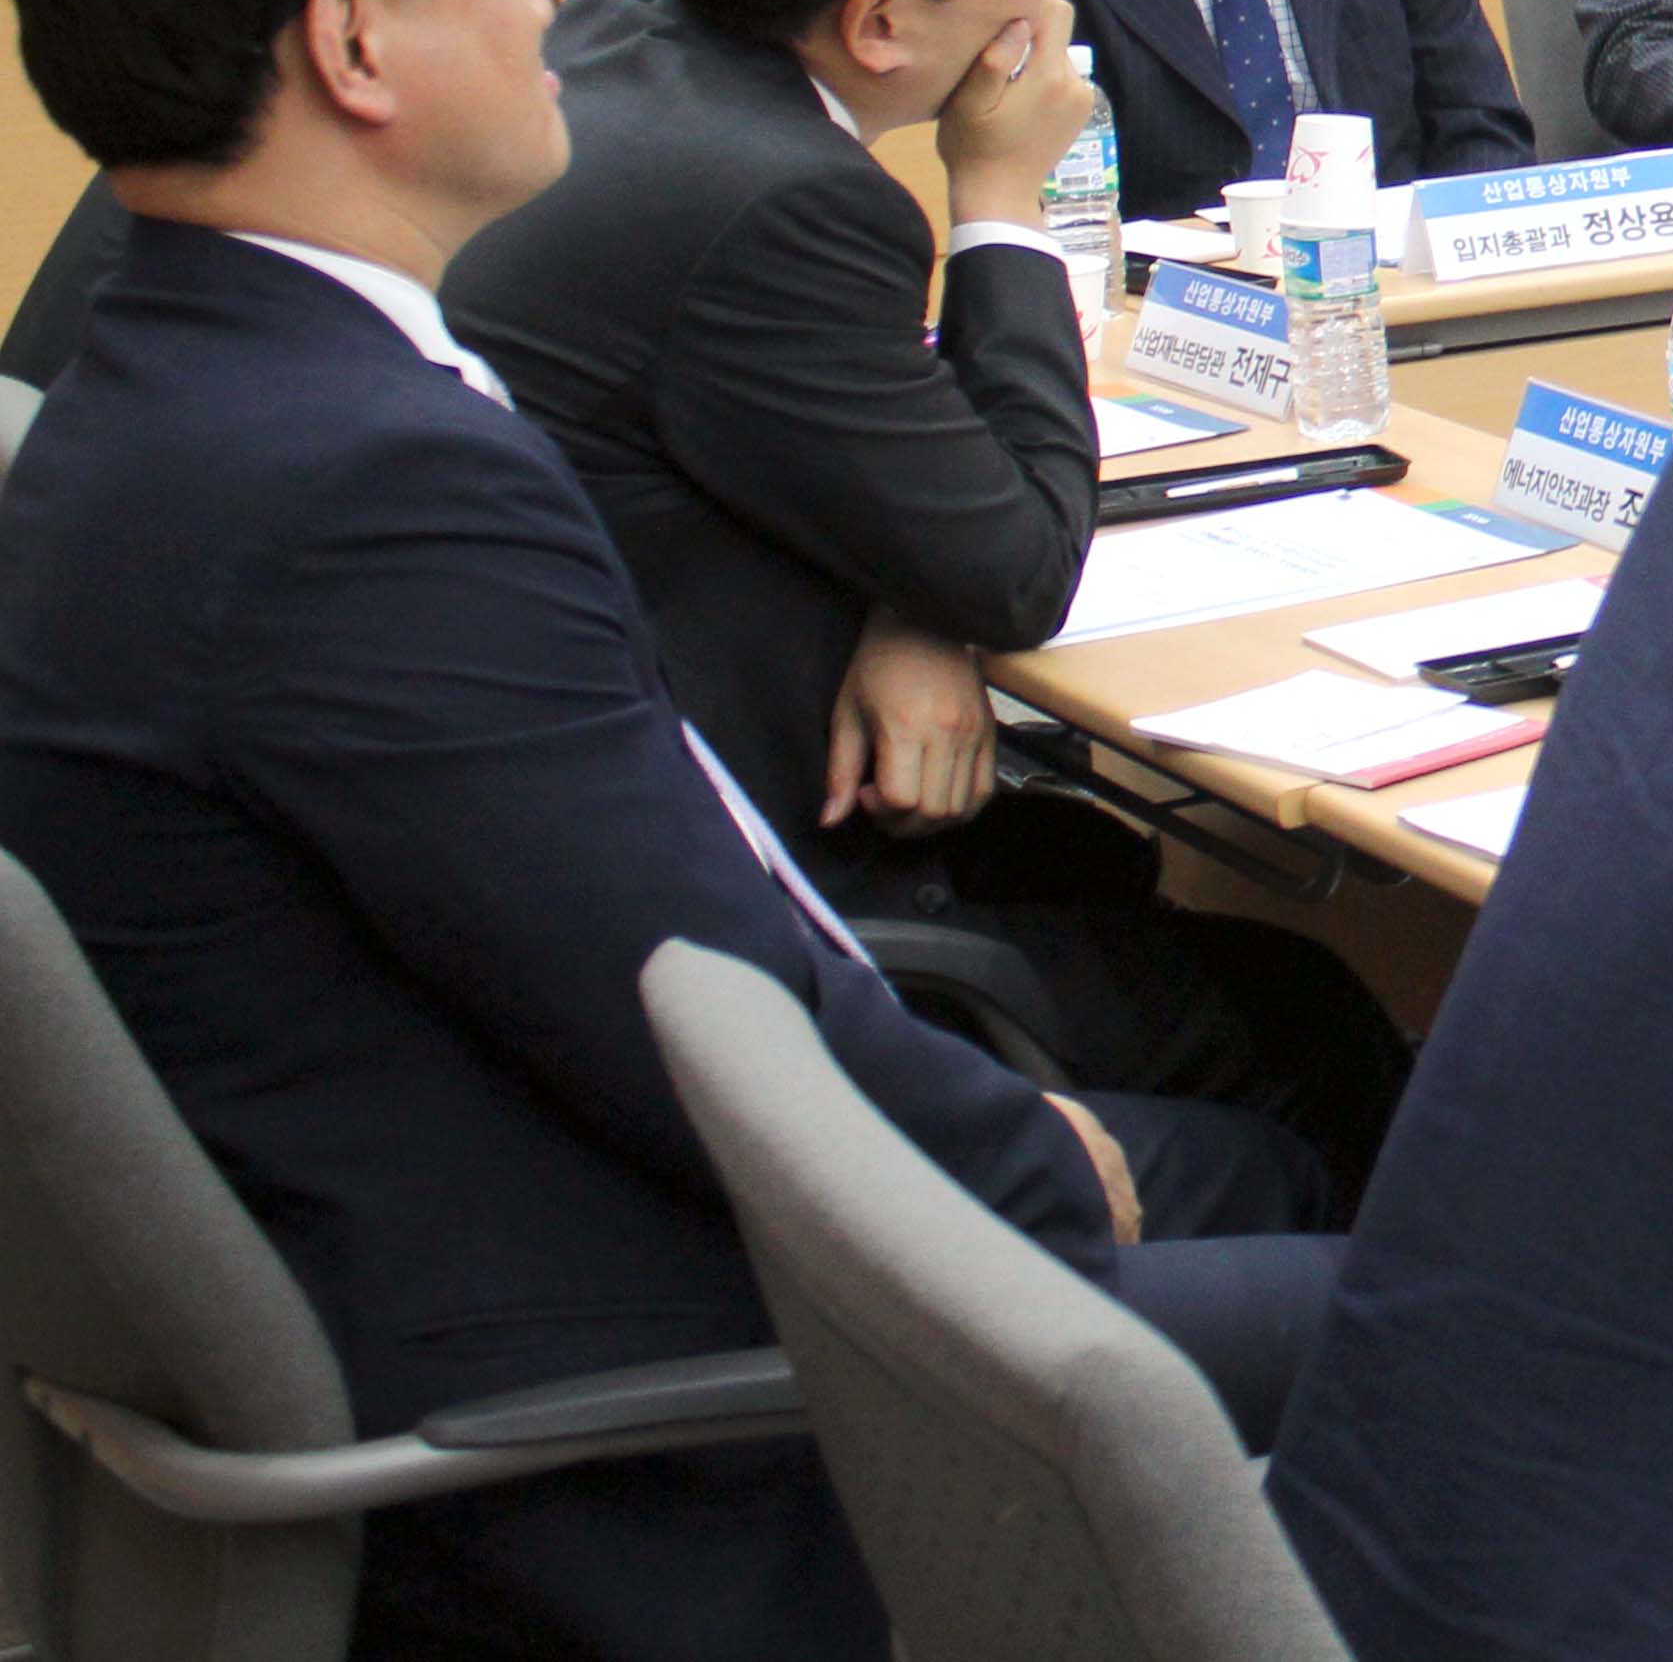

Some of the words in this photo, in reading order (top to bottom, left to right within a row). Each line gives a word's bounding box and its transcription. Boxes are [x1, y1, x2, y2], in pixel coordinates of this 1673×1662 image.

[1481, 165, 1633, 205] 산업통상자원부
[1452, 223, 1572, 263] 입지총괄과
[1183, 278, 1276, 328] 산업통상자원부
[1132, 325, 1227, 378] 산업재난담당관
[1229, 346, 1292, 399] 전제구
[1558, 405, 1668, 466] 산업통상자원부
[1502, 457, 1613, 523] 에너지안전과장
